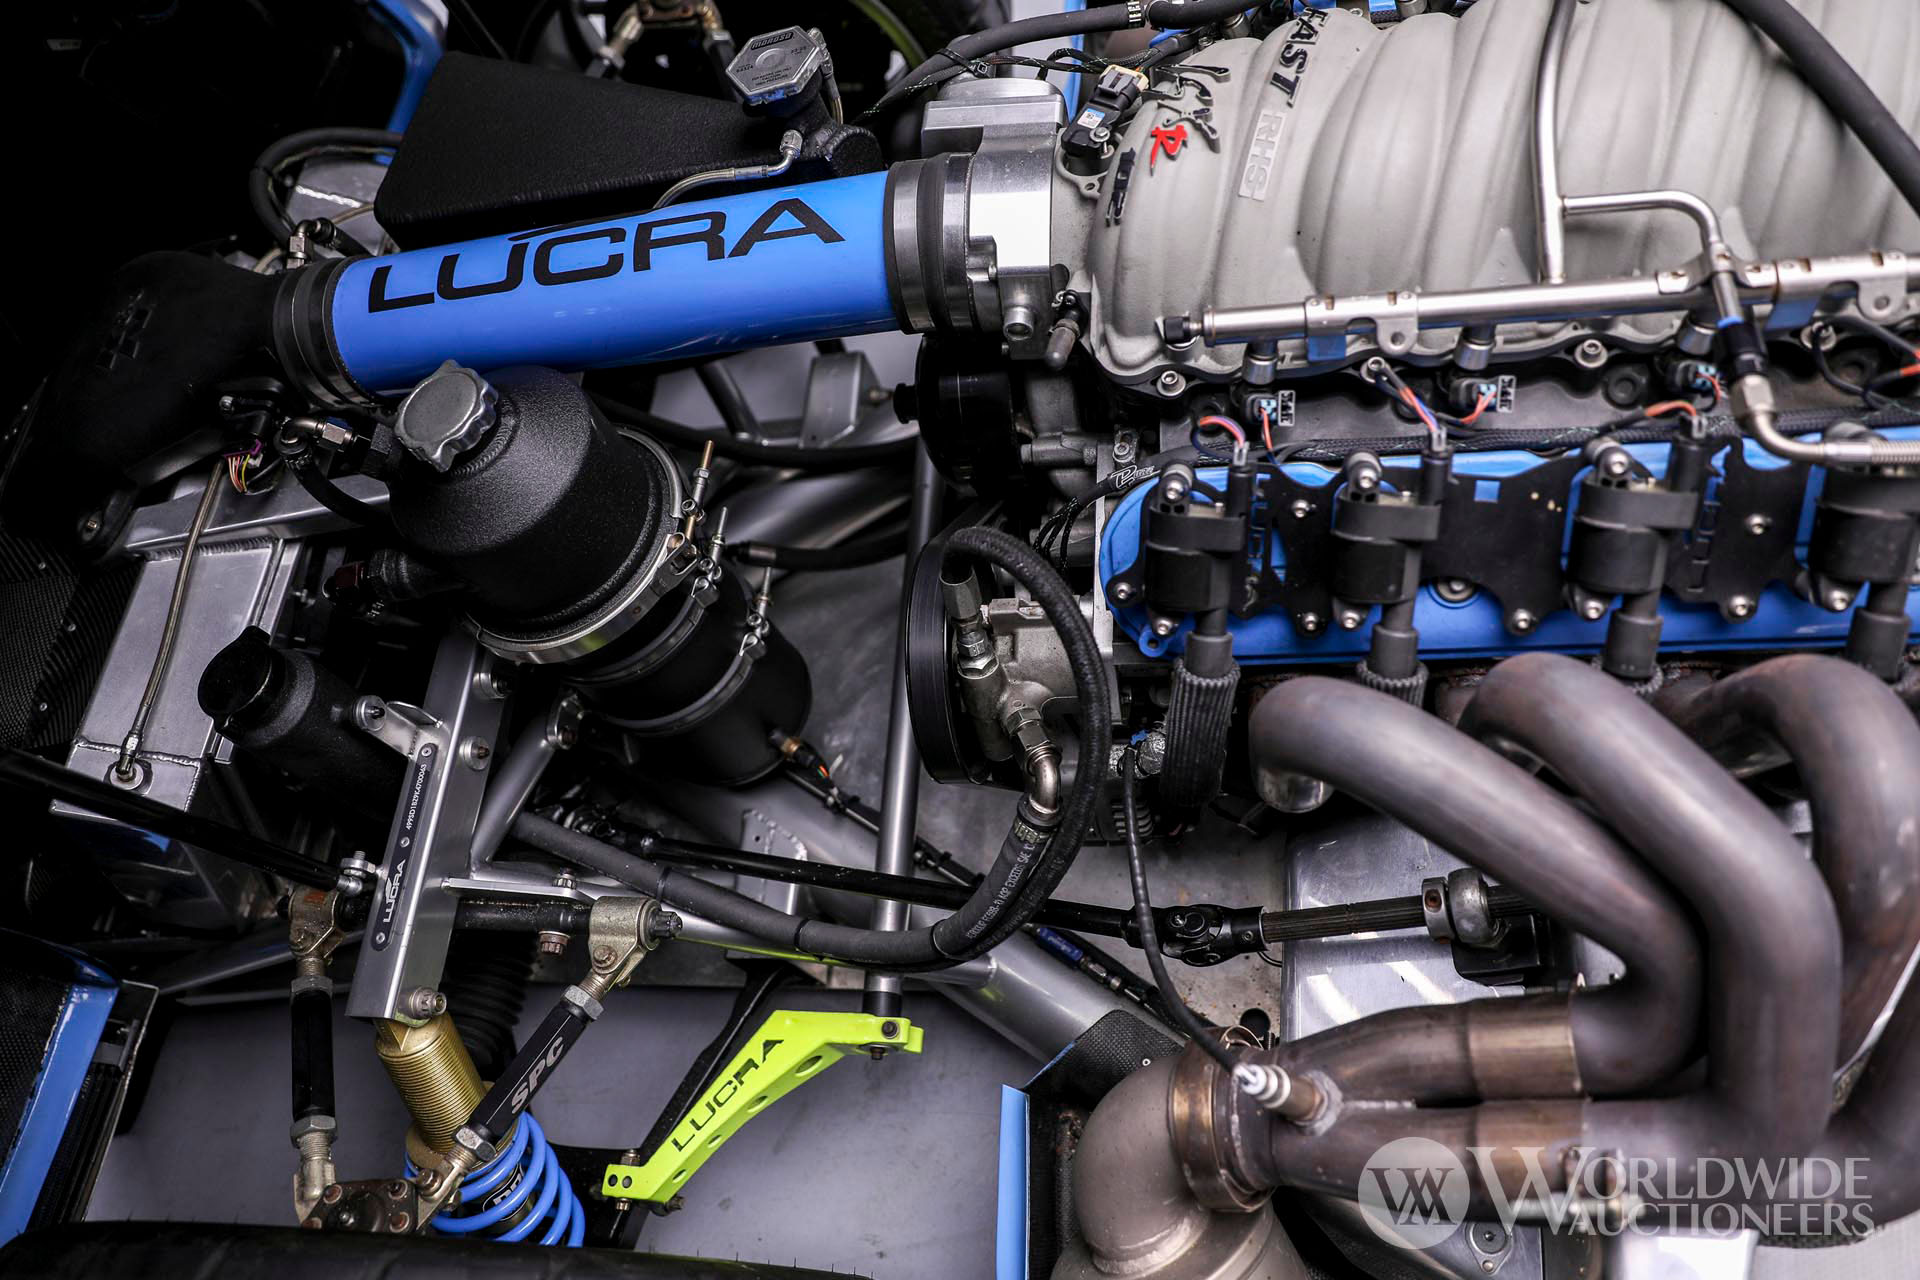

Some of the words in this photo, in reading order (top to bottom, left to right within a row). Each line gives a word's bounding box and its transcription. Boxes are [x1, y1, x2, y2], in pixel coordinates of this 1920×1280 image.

[1270, 6, 1329, 108] FAST
[1239, 111, 1286, 201] RHS
[368, 198, 846, 313] LUCRA
[383, 858, 406, 923] LUCRA
[511, 1036, 564, 1114] SPC
[671, 1039, 784, 1152] LUCRA
